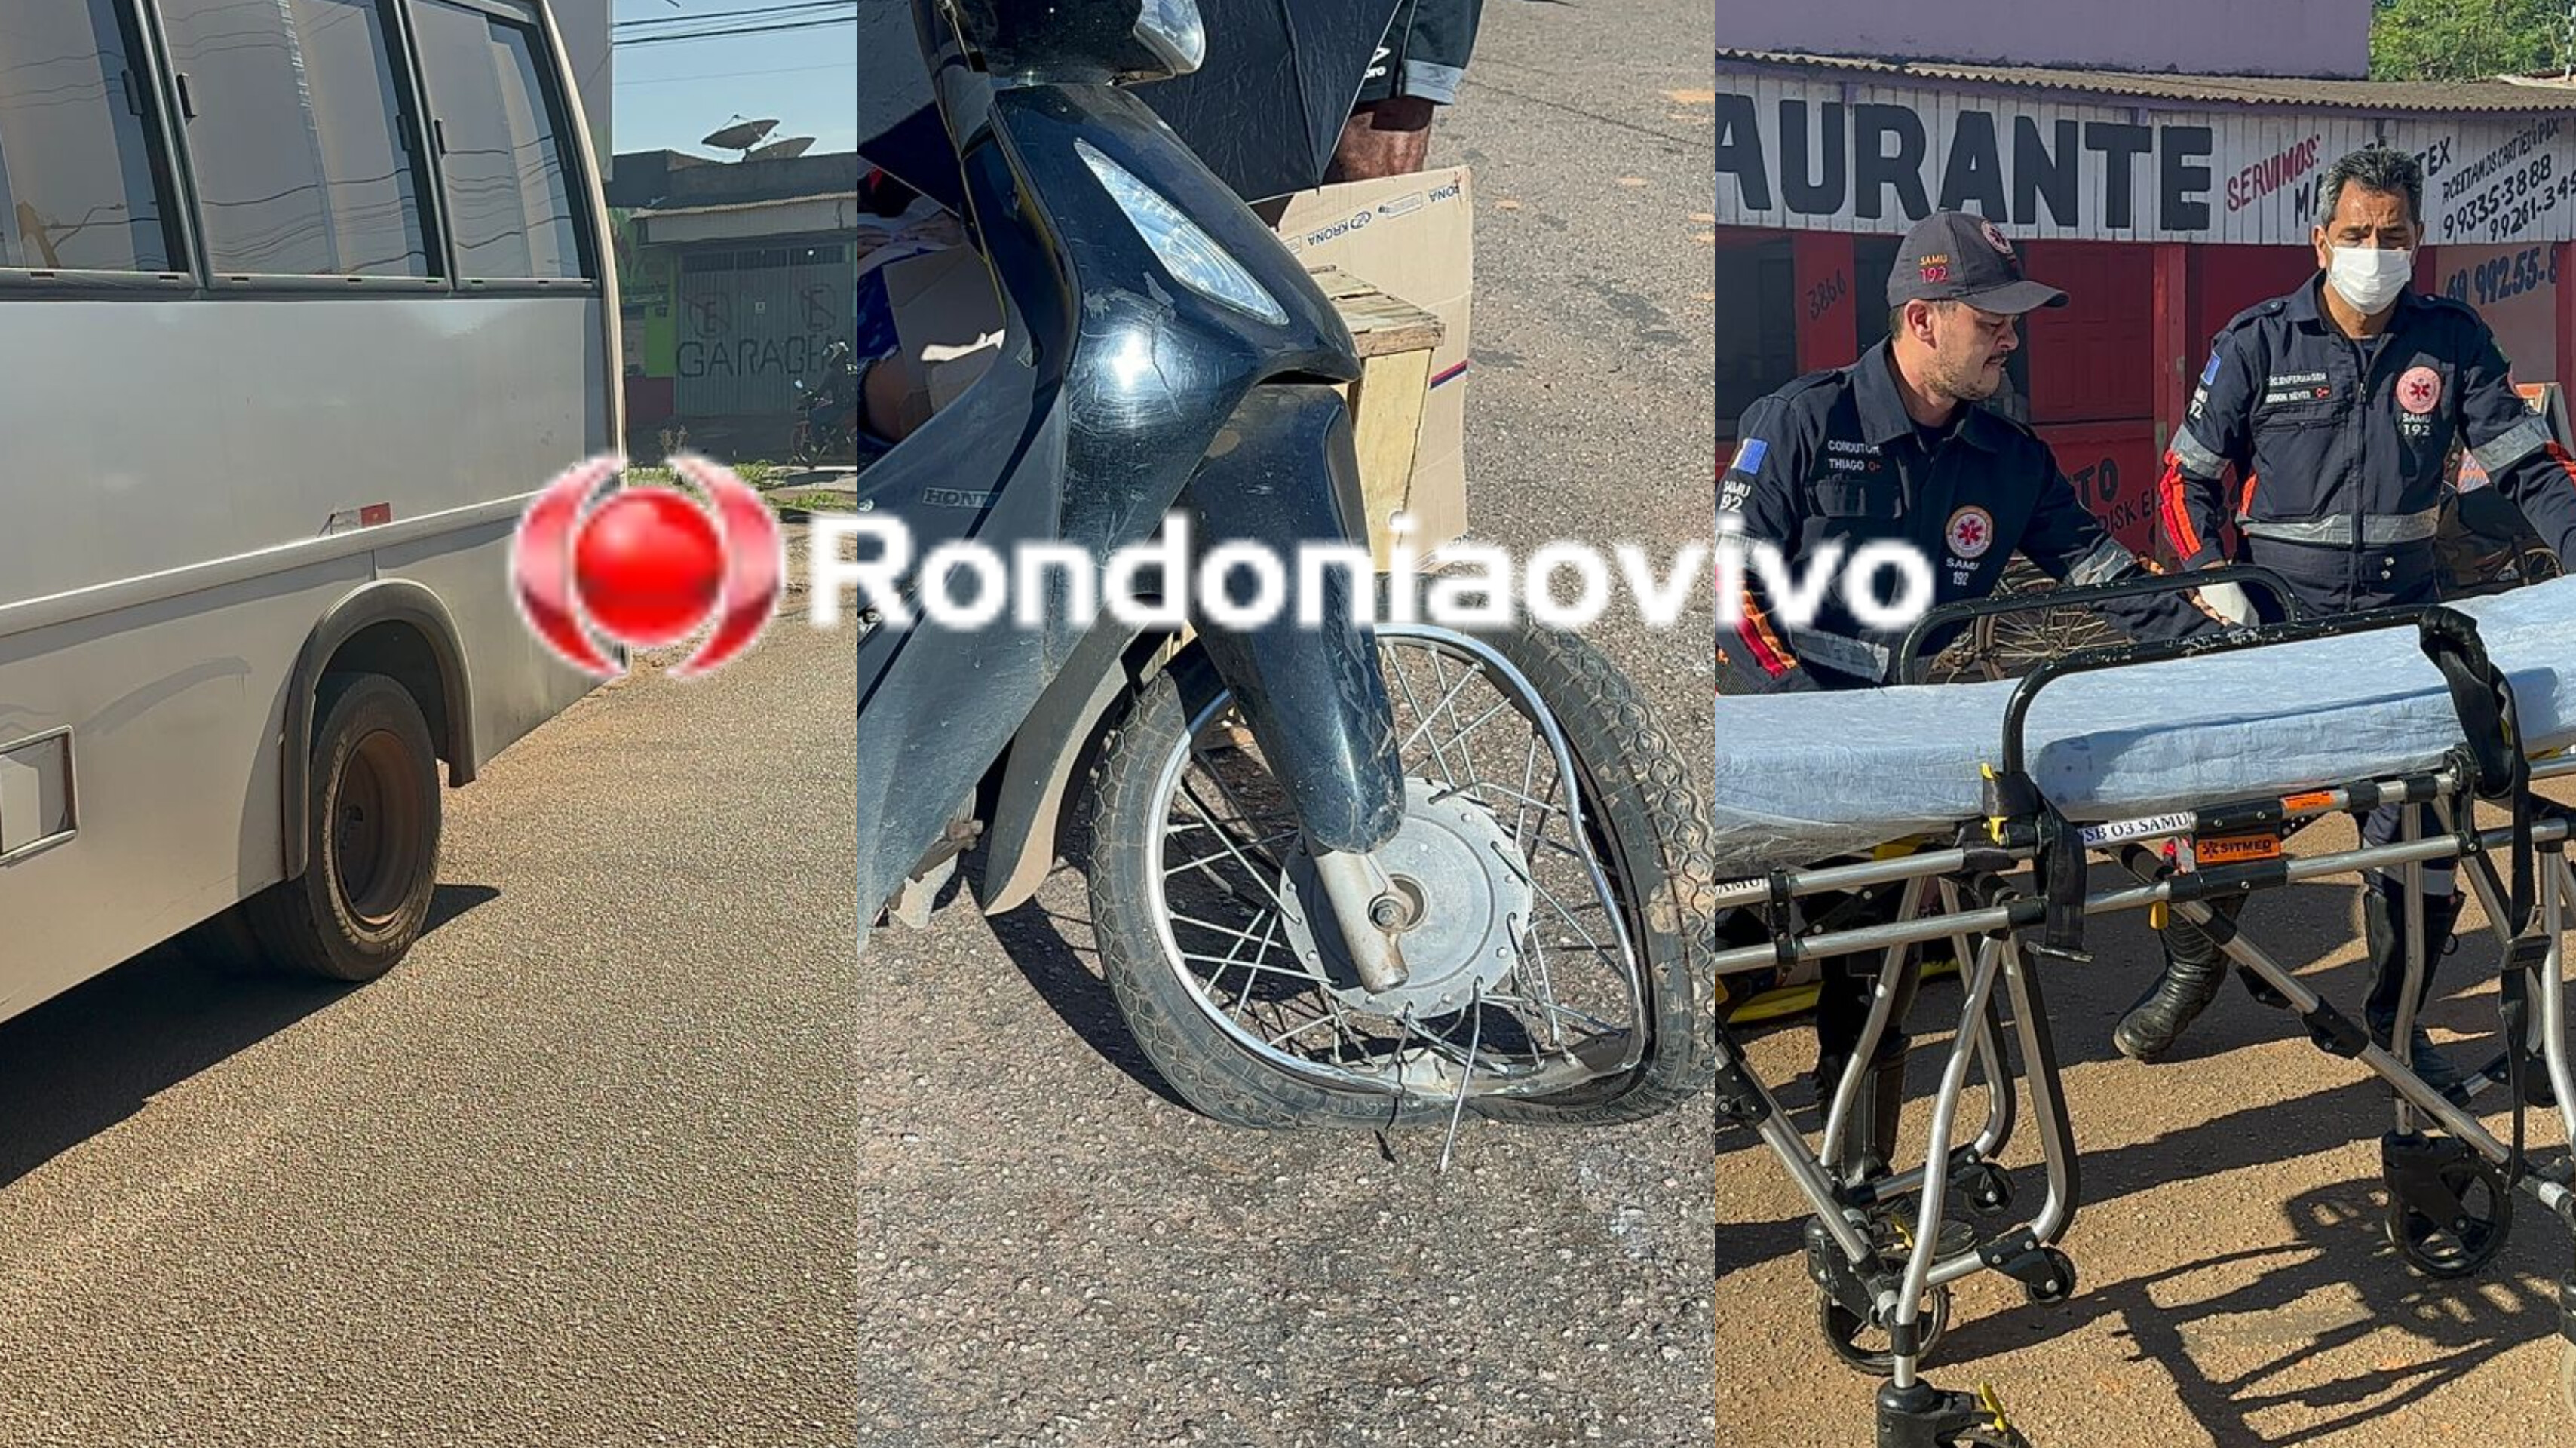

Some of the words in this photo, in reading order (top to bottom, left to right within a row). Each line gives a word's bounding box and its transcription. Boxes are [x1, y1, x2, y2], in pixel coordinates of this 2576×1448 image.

[1715, 93, 2213, 231] AURANTE
[1307, 219, 1350, 246] KRONA
[1919, 254, 1949, 266] SAMU
[1919, 266, 1949, 284] 192
[1808, 268, 1848, 321] 3866
[2402, 412, 2432, 423] SAMU
[2403, 423, 2430, 437] 192
[1828, 457, 1865, 471] THIAGO
[2139, 814, 2188, 833] SAMU
[2219, 839, 2272, 854] SITMED
